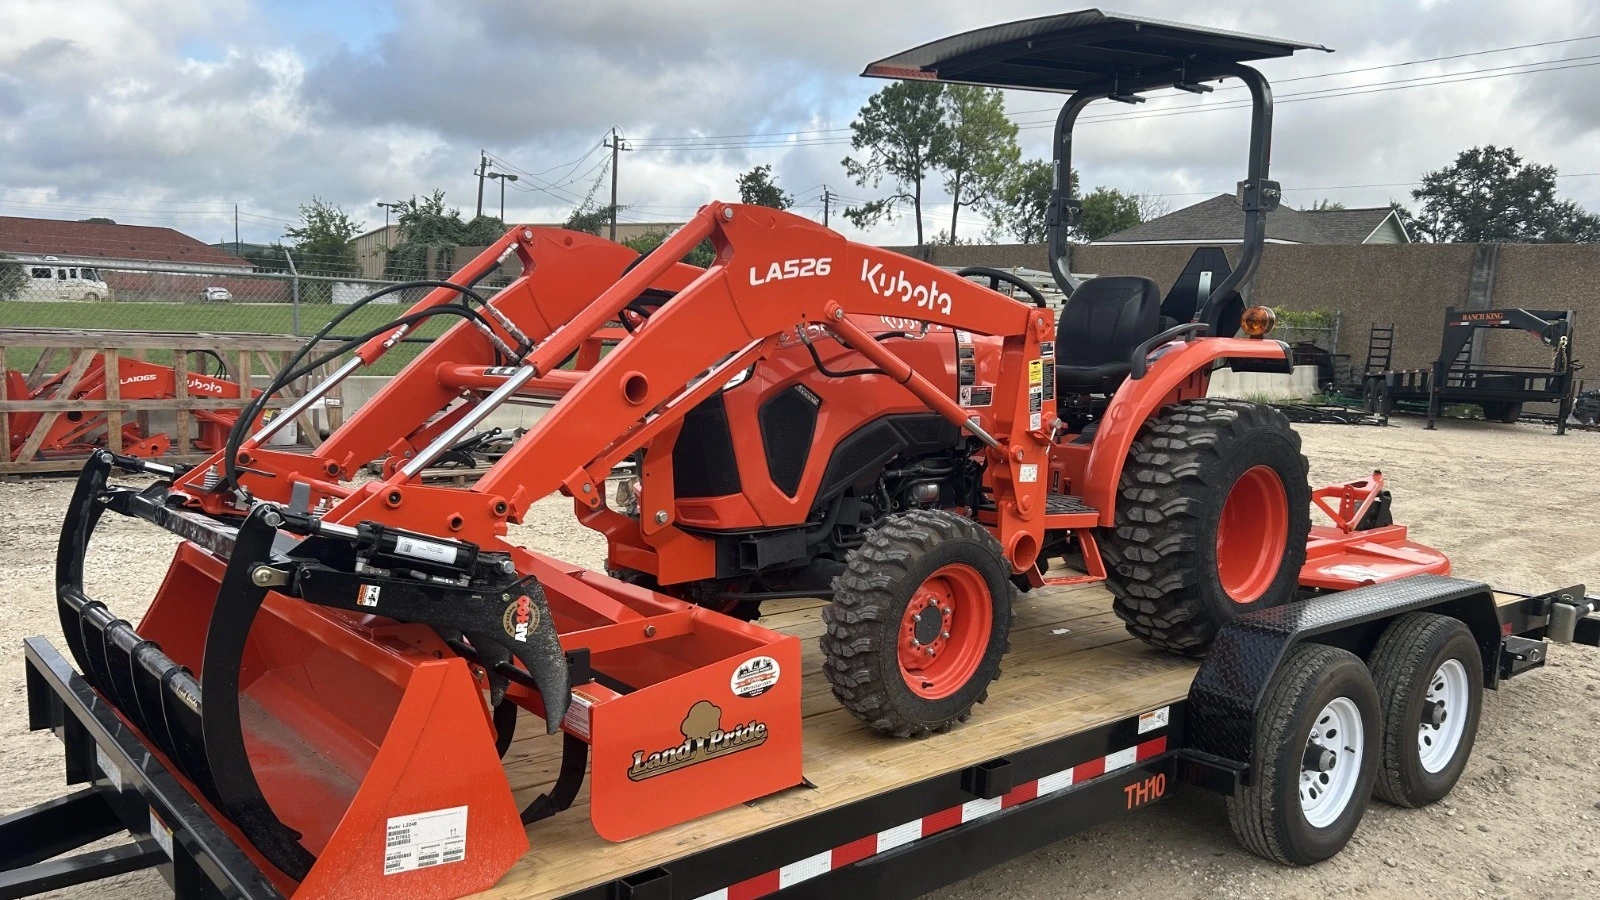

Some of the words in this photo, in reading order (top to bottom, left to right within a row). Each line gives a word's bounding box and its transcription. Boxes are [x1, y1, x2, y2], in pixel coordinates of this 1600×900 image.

[749, 257, 833, 287] LA526
[860, 258, 953, 316] Kubota
[187, 378, 223, 393] ubota
[630, 738, 693, 775] Land
[706, 720, 766, 752] Pride
[1124, 772, 1166, 810] TH10
